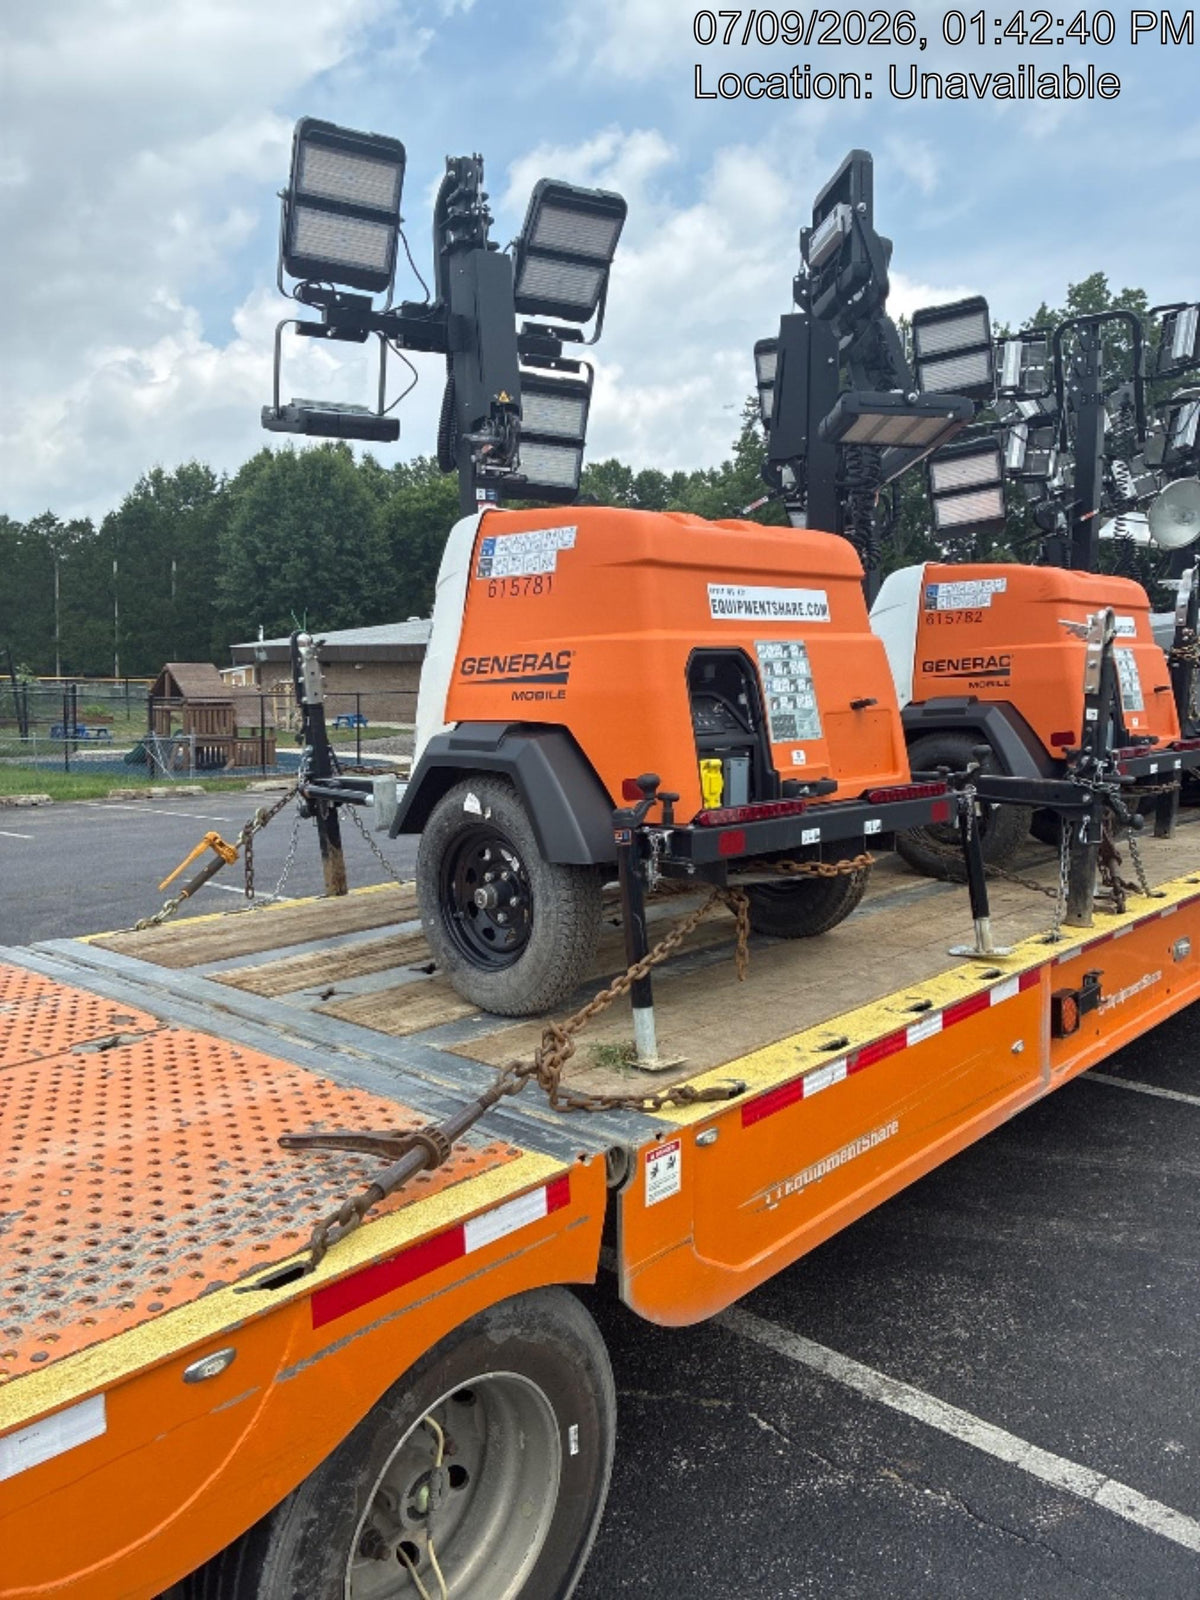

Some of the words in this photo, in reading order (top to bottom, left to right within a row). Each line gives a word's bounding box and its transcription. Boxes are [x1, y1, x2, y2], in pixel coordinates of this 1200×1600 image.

[488, 575, 553, 598] 615781
[711, 598, 828, 617] EQUIPMENTSHARE.COM
[925, 611, 983, 625] 615782
[460, 650, 572, 676] GENERAC
[922, 655, 1011, 673] GENERAC
[968, 680, 1011, 689] MOBILE
[511, 689, 566, 701] MOBILE
